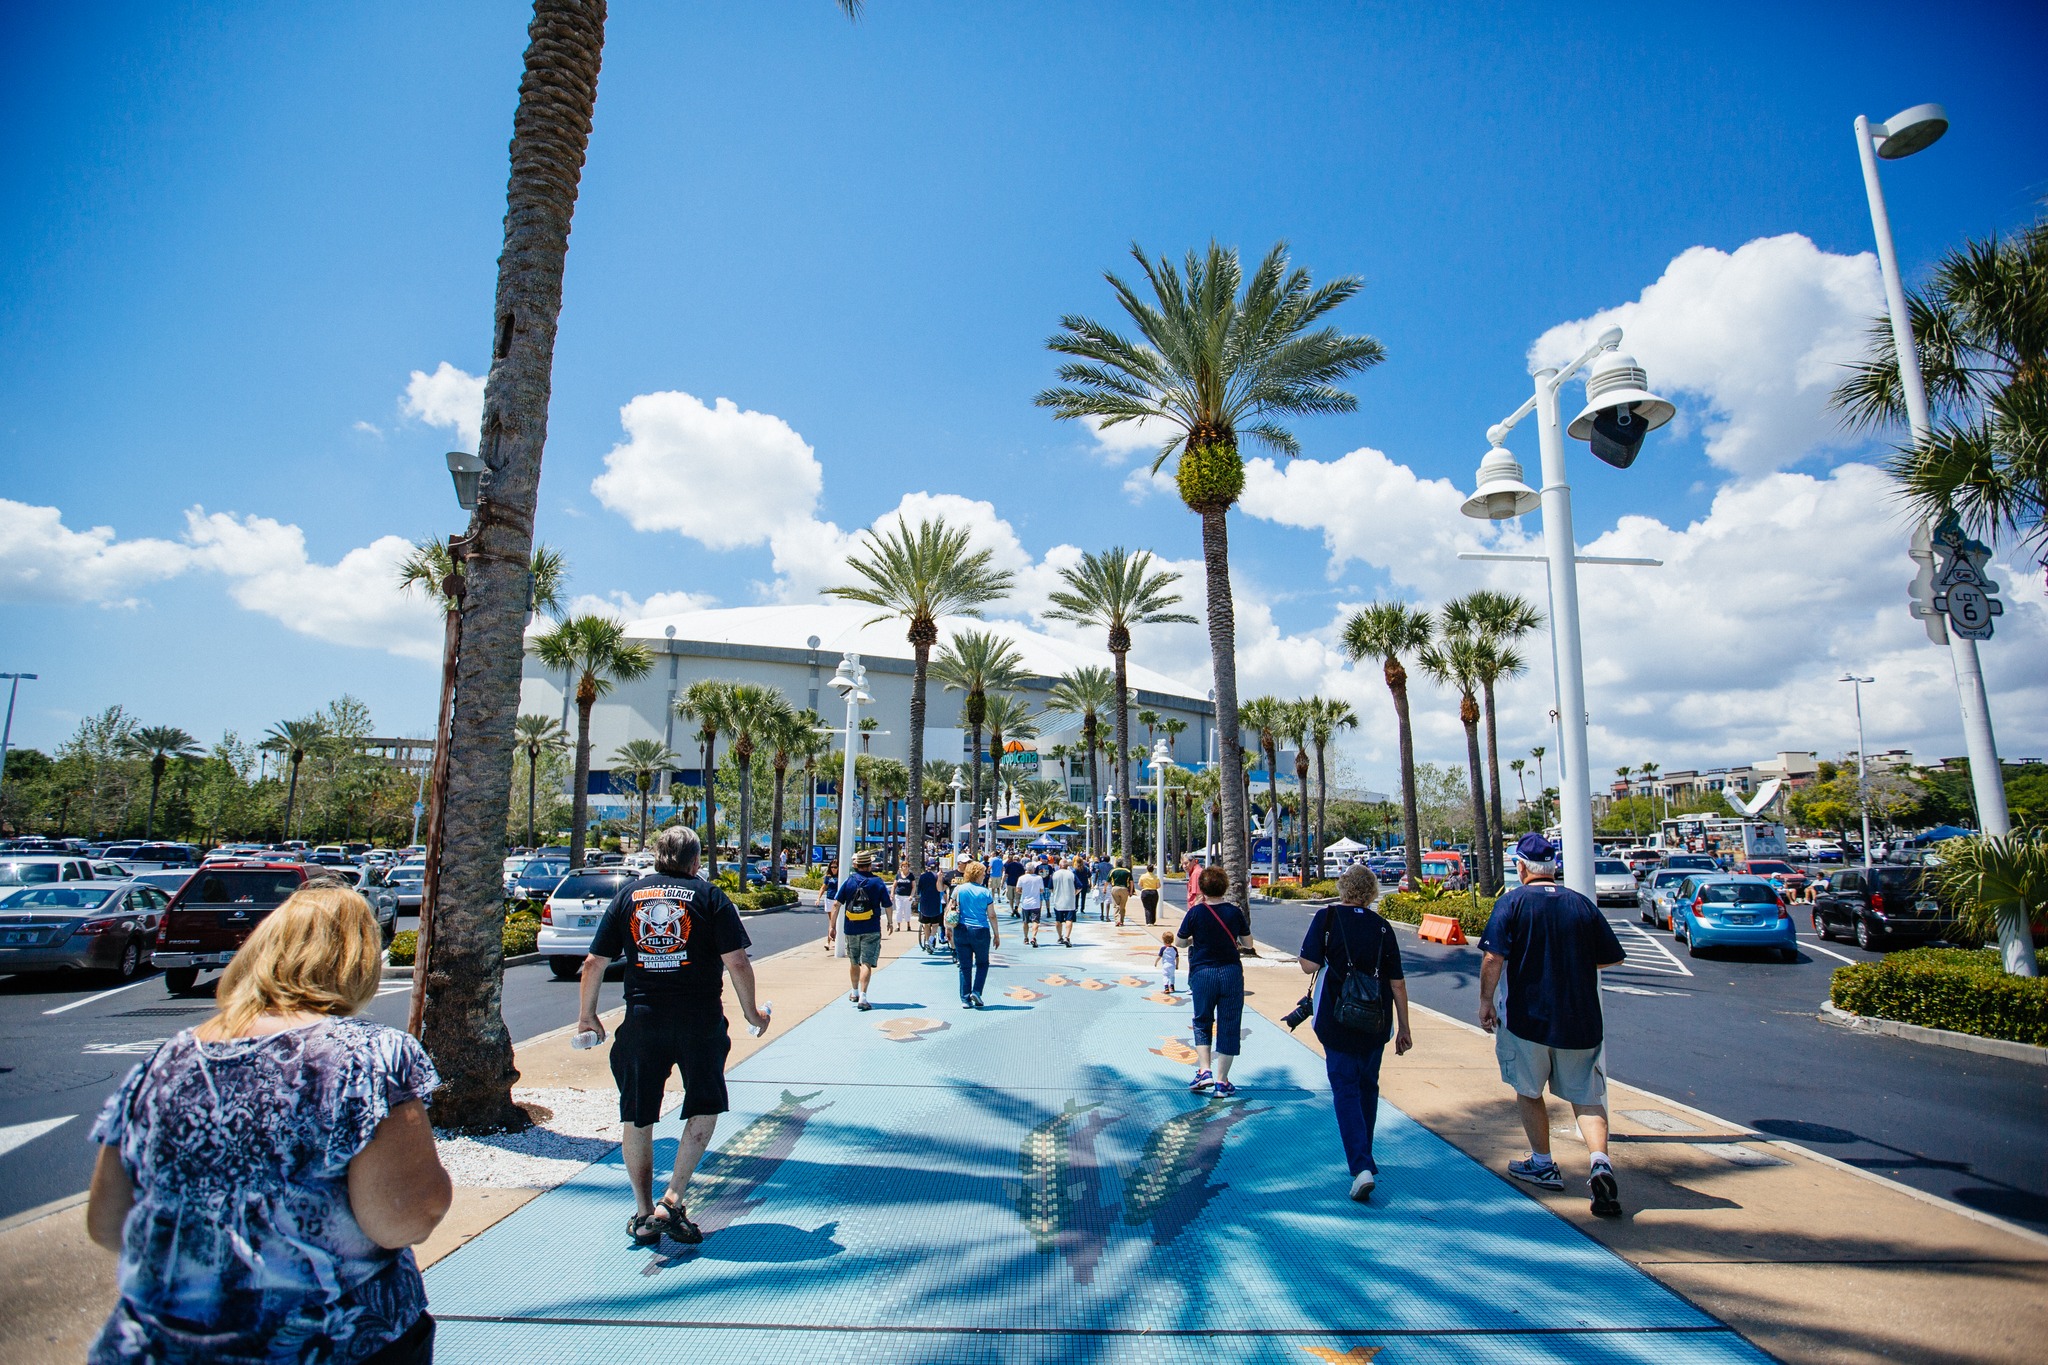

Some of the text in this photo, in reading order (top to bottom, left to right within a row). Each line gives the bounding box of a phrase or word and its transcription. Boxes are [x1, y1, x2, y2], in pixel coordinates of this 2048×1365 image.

[1955, 593, 1979, 602] LOT
[1963, 603, 1978, 621] 6
[1753, 842, 1781, 854] abc
[646, 937, 661, 945] TIL
[644, 960, 681, 969] BALTIMORE
